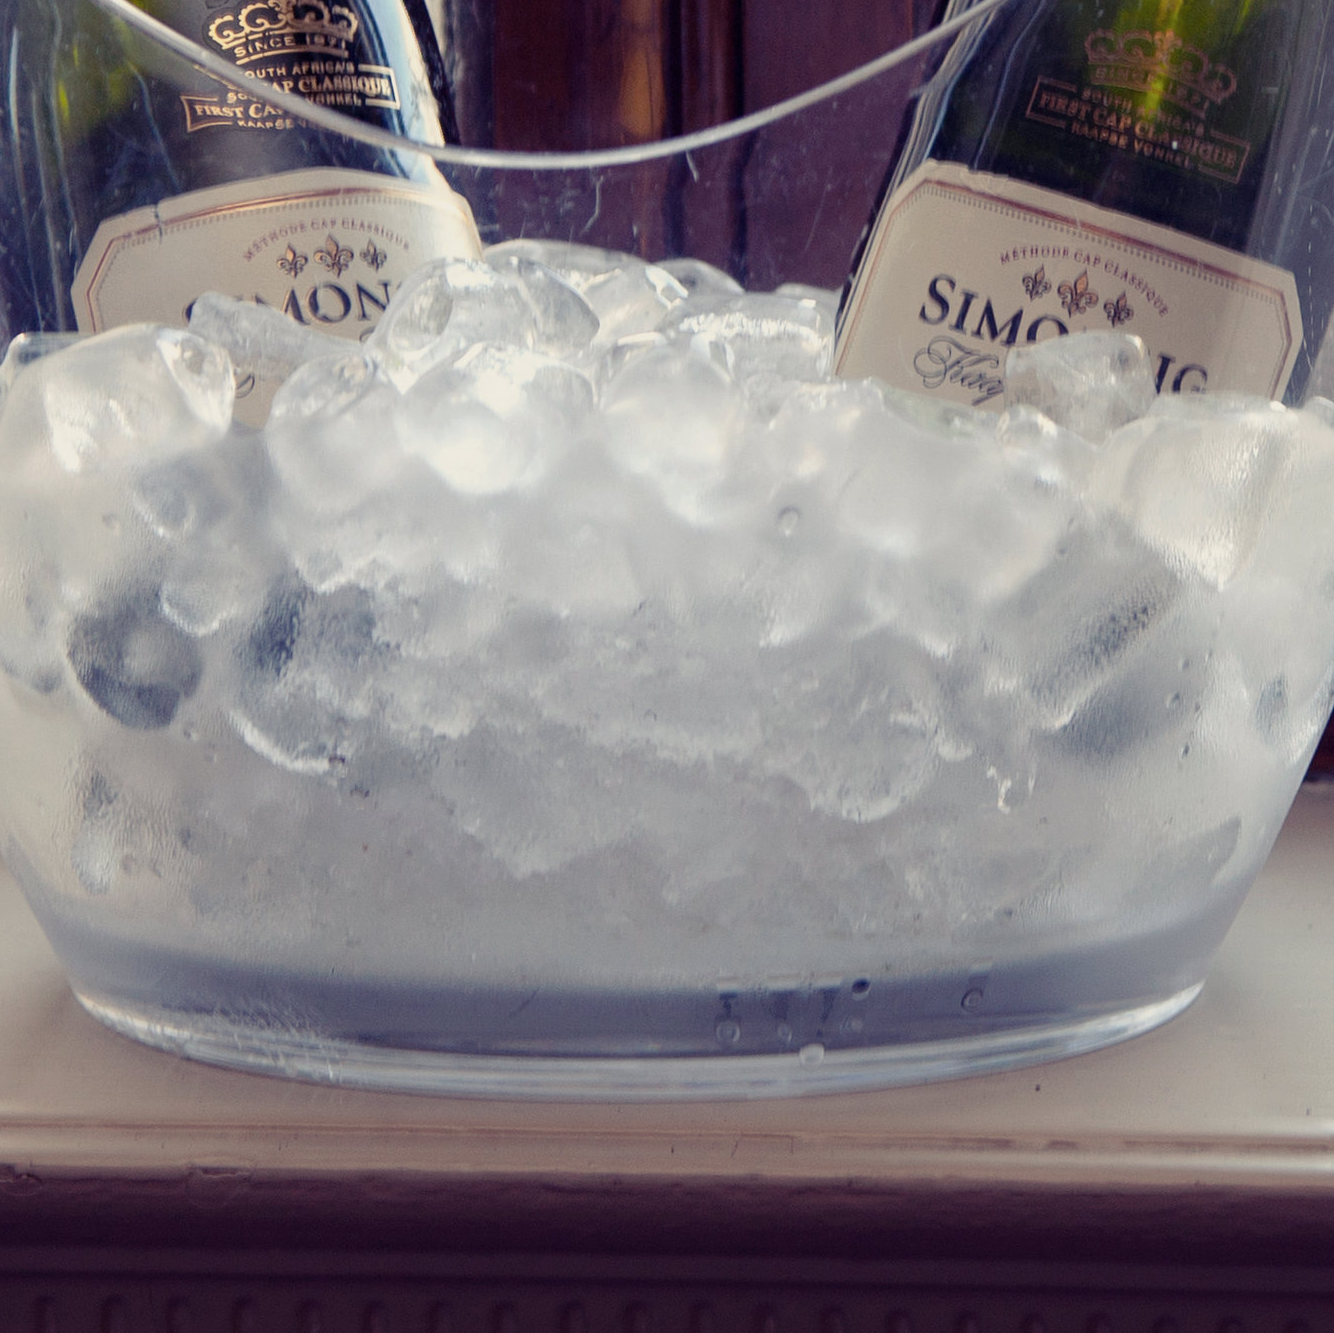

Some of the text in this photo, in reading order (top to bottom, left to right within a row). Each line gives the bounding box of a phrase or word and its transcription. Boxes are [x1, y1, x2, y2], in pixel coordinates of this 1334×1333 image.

[233, 35, 296, 58] SINCE
[240, 64, 286, 79] OUTH
[264, 74, 392, 97] AP CLASSIQUE
[193, 104, 244, 118] FIRST
[1039, 89, 1093, 118] FIRST
[1092, 107, 1132, 132] CAP
[236, 117, 295, 130] KAAPSE
[310, 218, 337, 230] CAP
[341, 218, 410, 251] CLASSIQUE
[1073, 250, 1101, 268] CAP
[1104, 262, 1169, 318] CLASSIQUE
